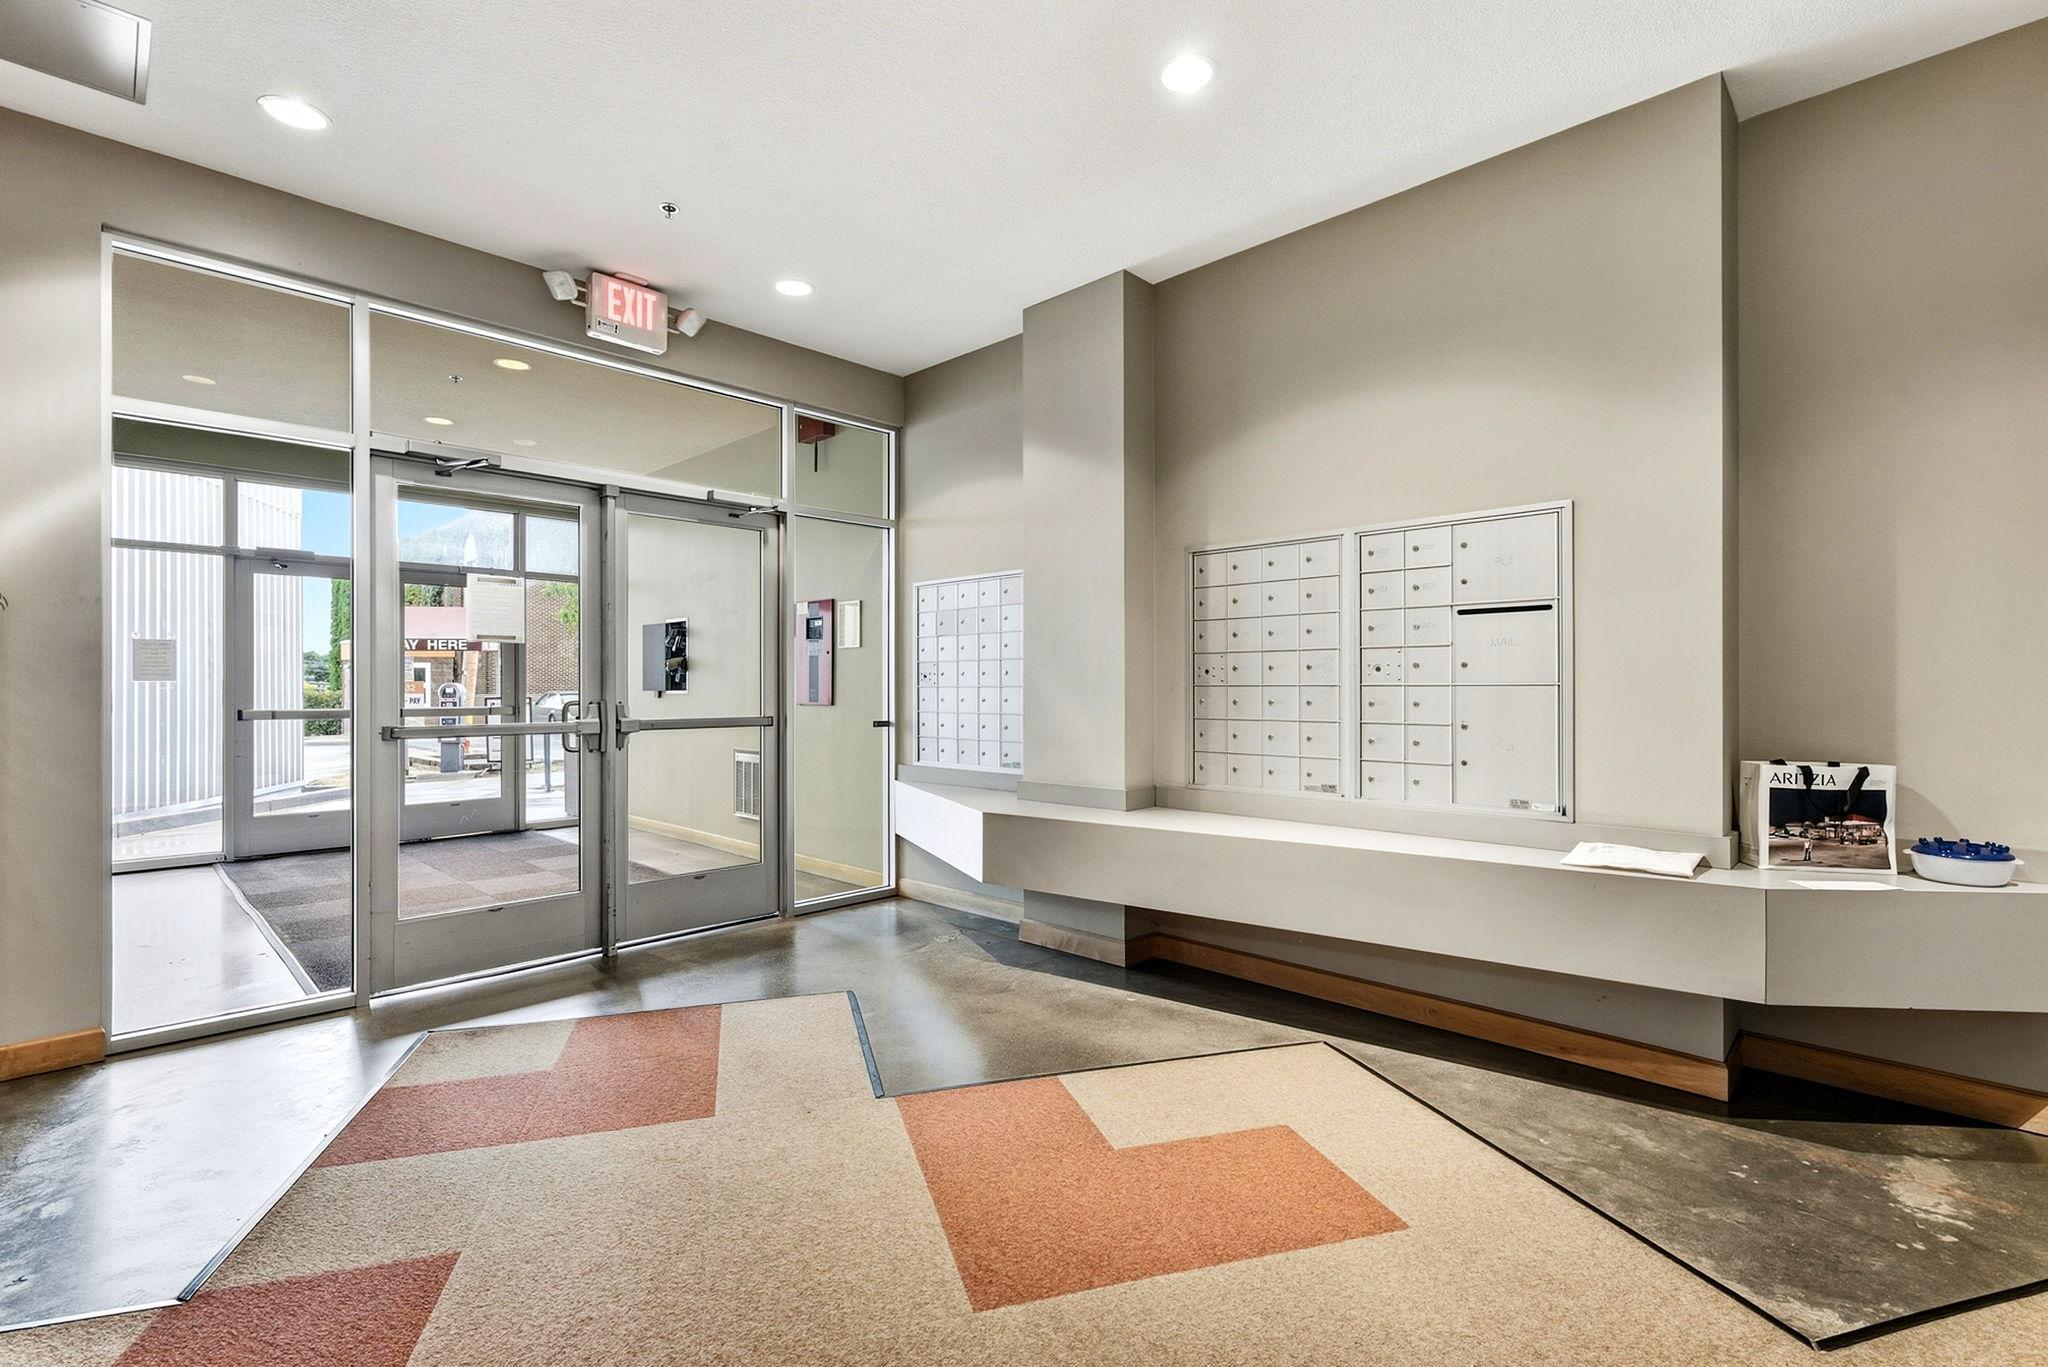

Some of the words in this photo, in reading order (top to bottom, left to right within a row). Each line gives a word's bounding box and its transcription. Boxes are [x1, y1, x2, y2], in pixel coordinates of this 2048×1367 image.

[607, 282, 657, 331] EXIT
[427, 639, 468, 650] HERE
[1489, 637, 1519, 648] MAIL
[1769, 772, 1837, 787] ARIZIA
